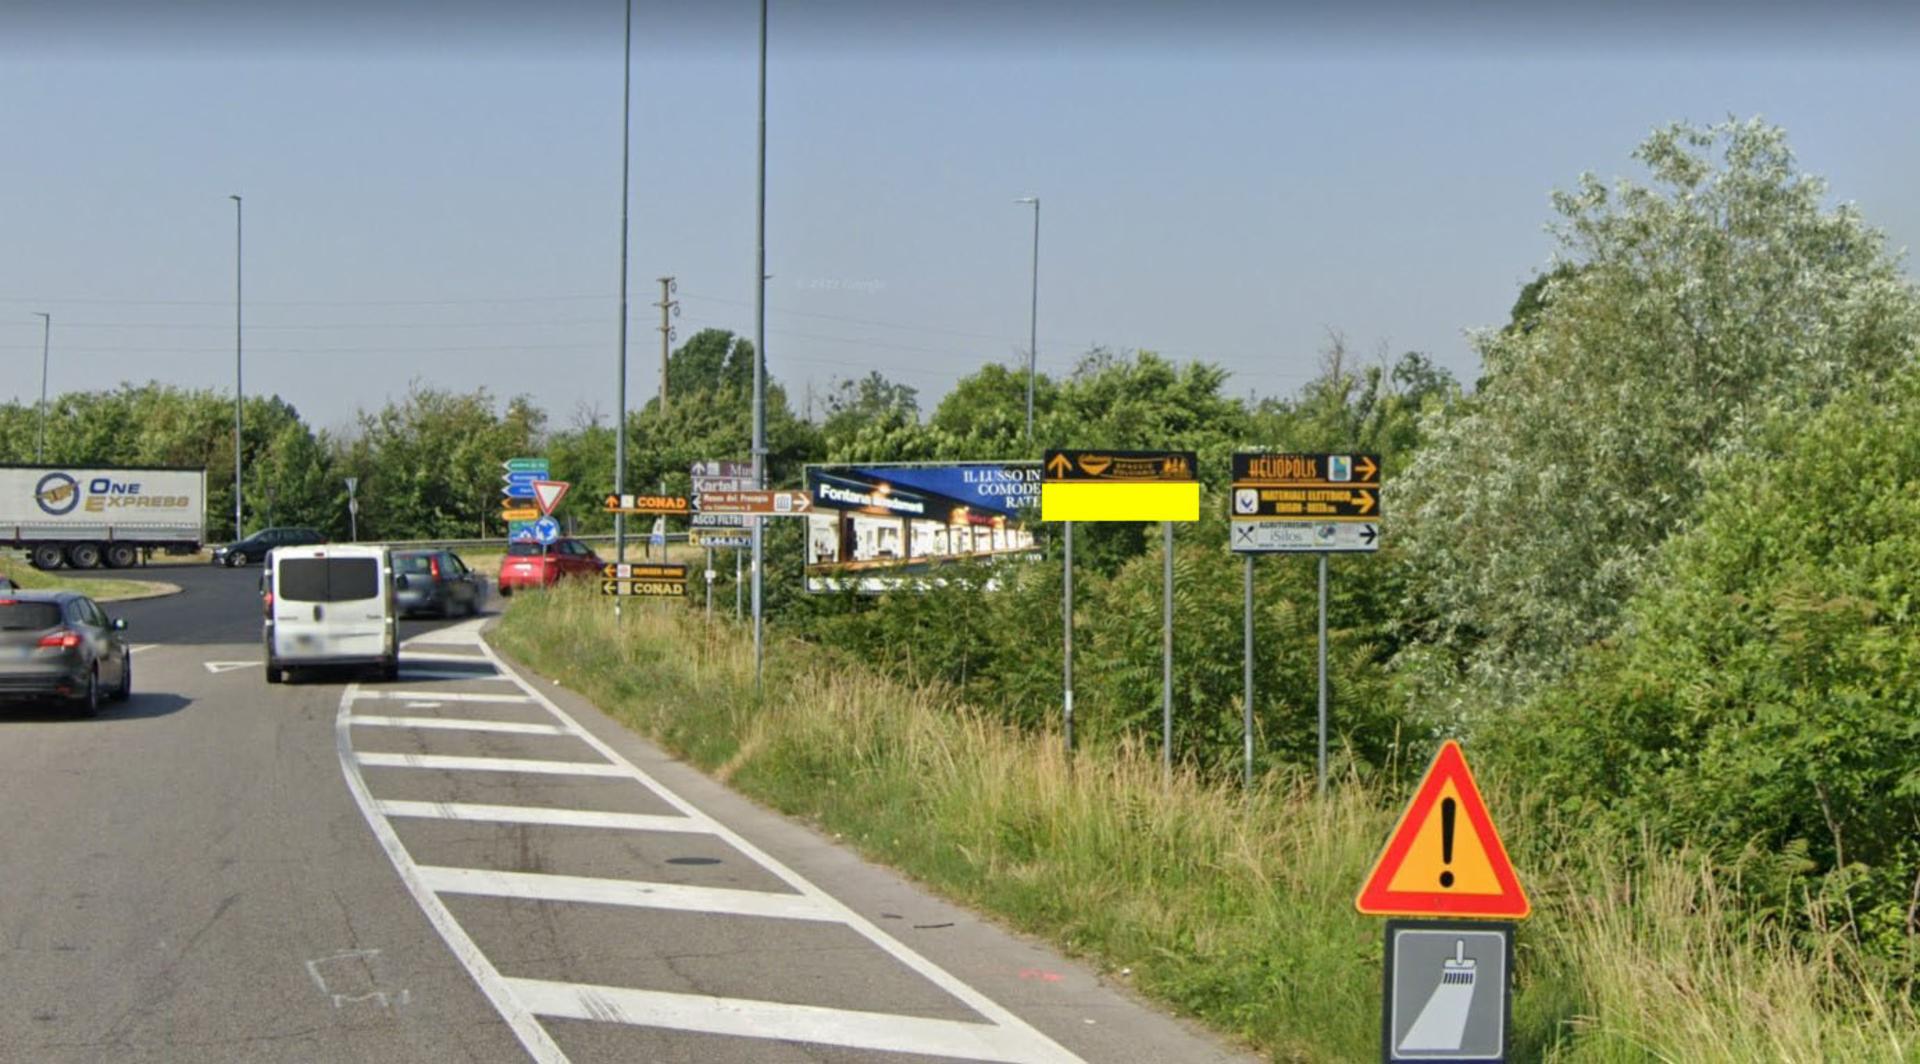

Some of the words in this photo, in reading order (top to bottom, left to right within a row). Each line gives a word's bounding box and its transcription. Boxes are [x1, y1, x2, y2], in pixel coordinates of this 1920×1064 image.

[1248, 458, 1317, 477] HELIOPOLIS
[963, 469, 978, 483] IL
[980, 469, 1024, 483] LUSSO
[1026, 469, 1041, 480] IN
[89, 478, 142, 494] ONE
[977, 483, 1041, 495] COMODE
[820, 483, 873, 505] Fontana
[85, 496, 190, 512] EXPRESS
[637, 496, 687, 509] CONAD
[1006, 496, 1041, 509] RATE
[634, 583, 684, 595] CONAD
